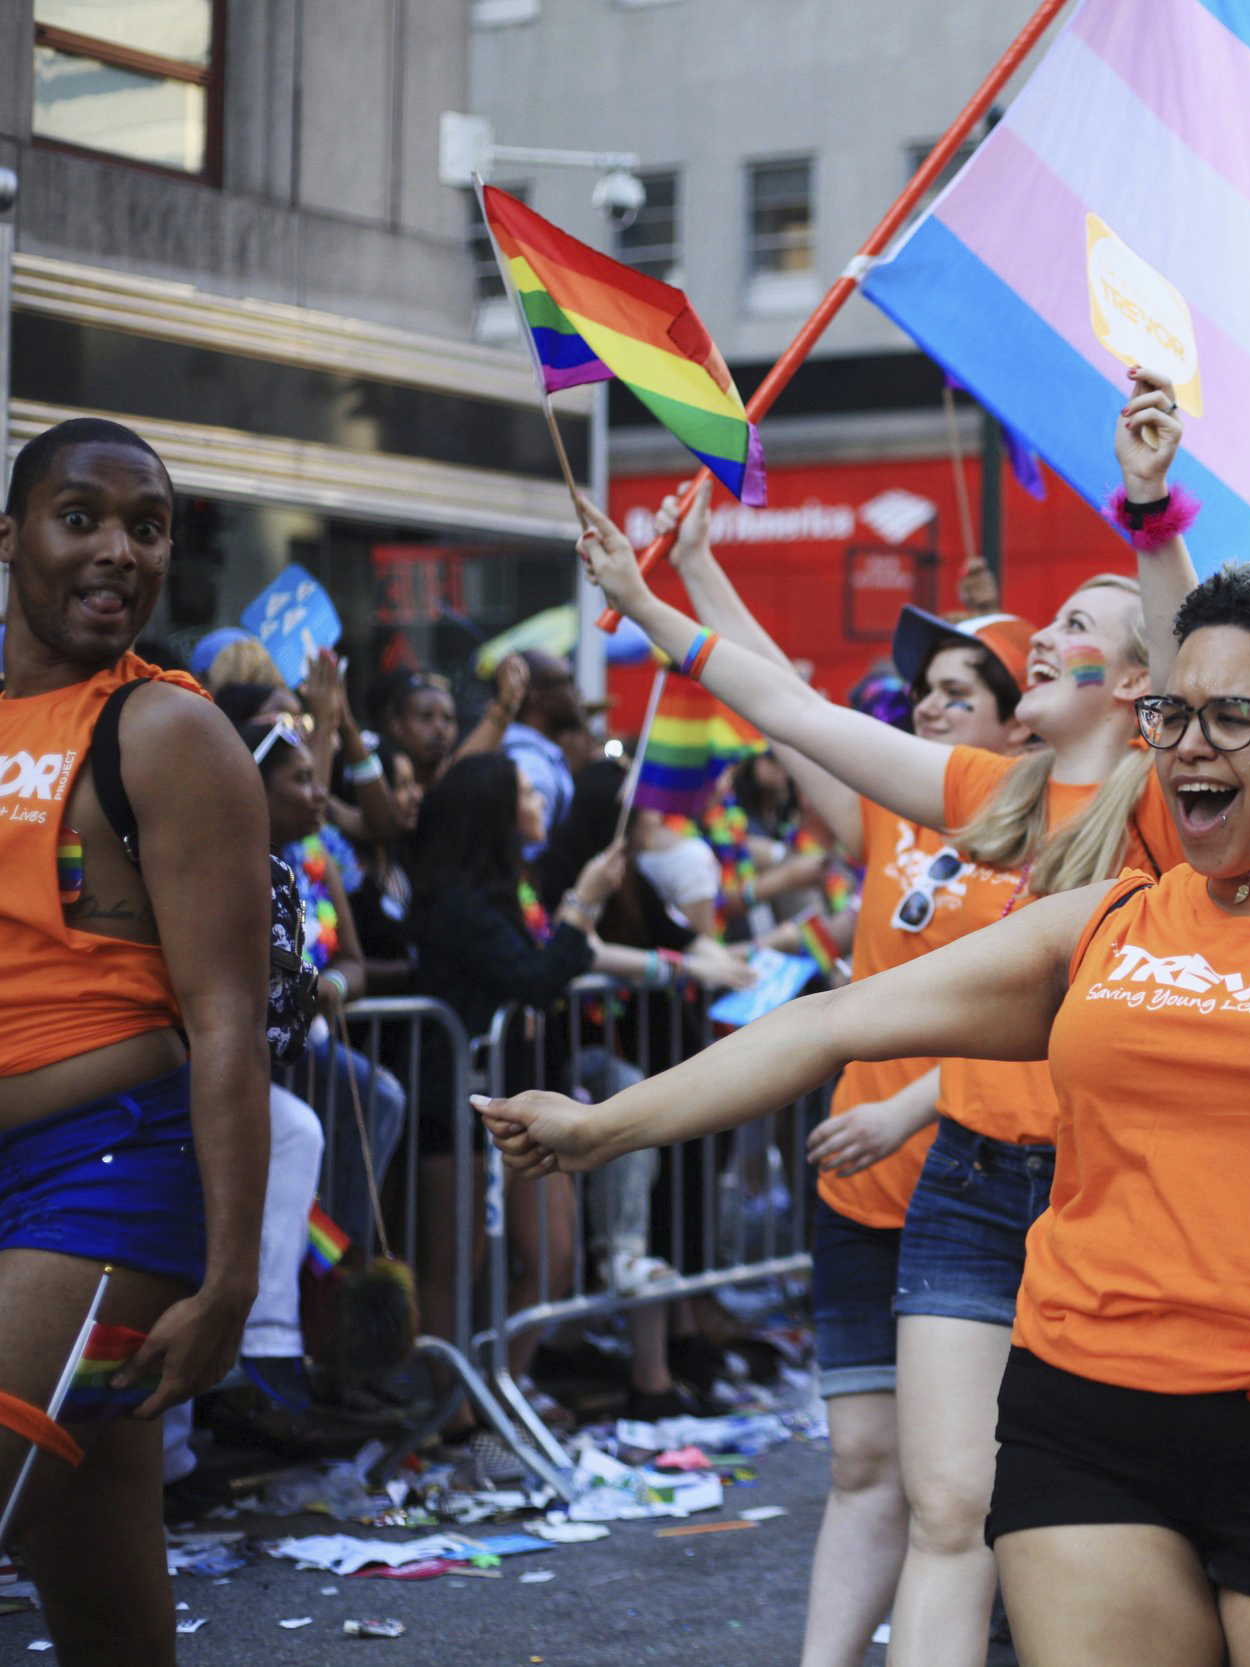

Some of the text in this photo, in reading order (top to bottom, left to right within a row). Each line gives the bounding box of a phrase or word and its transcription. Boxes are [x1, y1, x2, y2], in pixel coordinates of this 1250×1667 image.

[1101, 275, 1187, 363] TREVOR
[54, 749, 78, 801] PROJECT
[9, 804, 48, 824] Lives
[1086, 983, 1146, 1008] Saving
[1146, 989, 1216, 1014] Young
